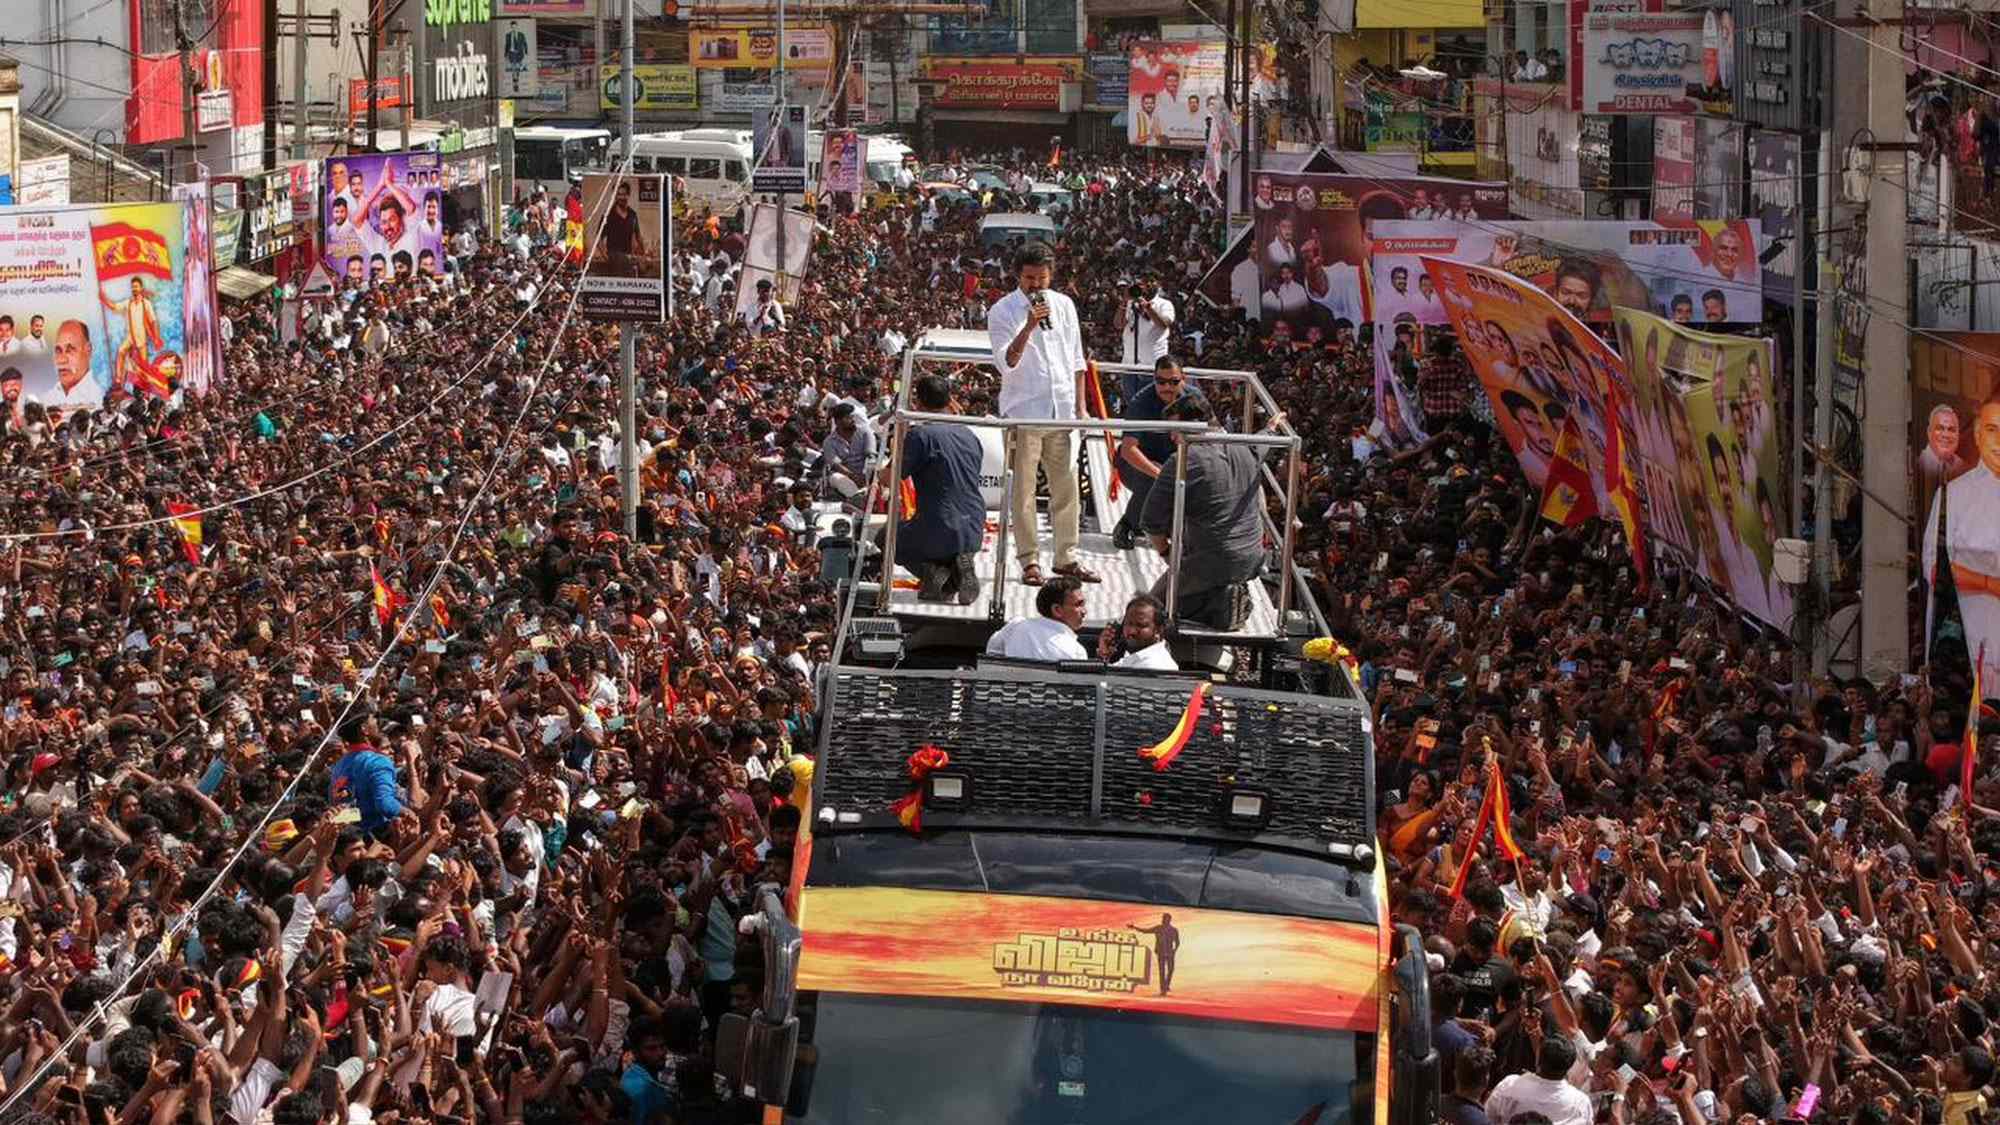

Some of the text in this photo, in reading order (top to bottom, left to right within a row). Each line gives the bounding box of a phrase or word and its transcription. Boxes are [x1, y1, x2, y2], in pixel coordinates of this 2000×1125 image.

[435, 40, 489, 101] mobiles
[1615, 95, 1672, 109] DENTAL
[994, 933, 1149, 982] விஜய்
